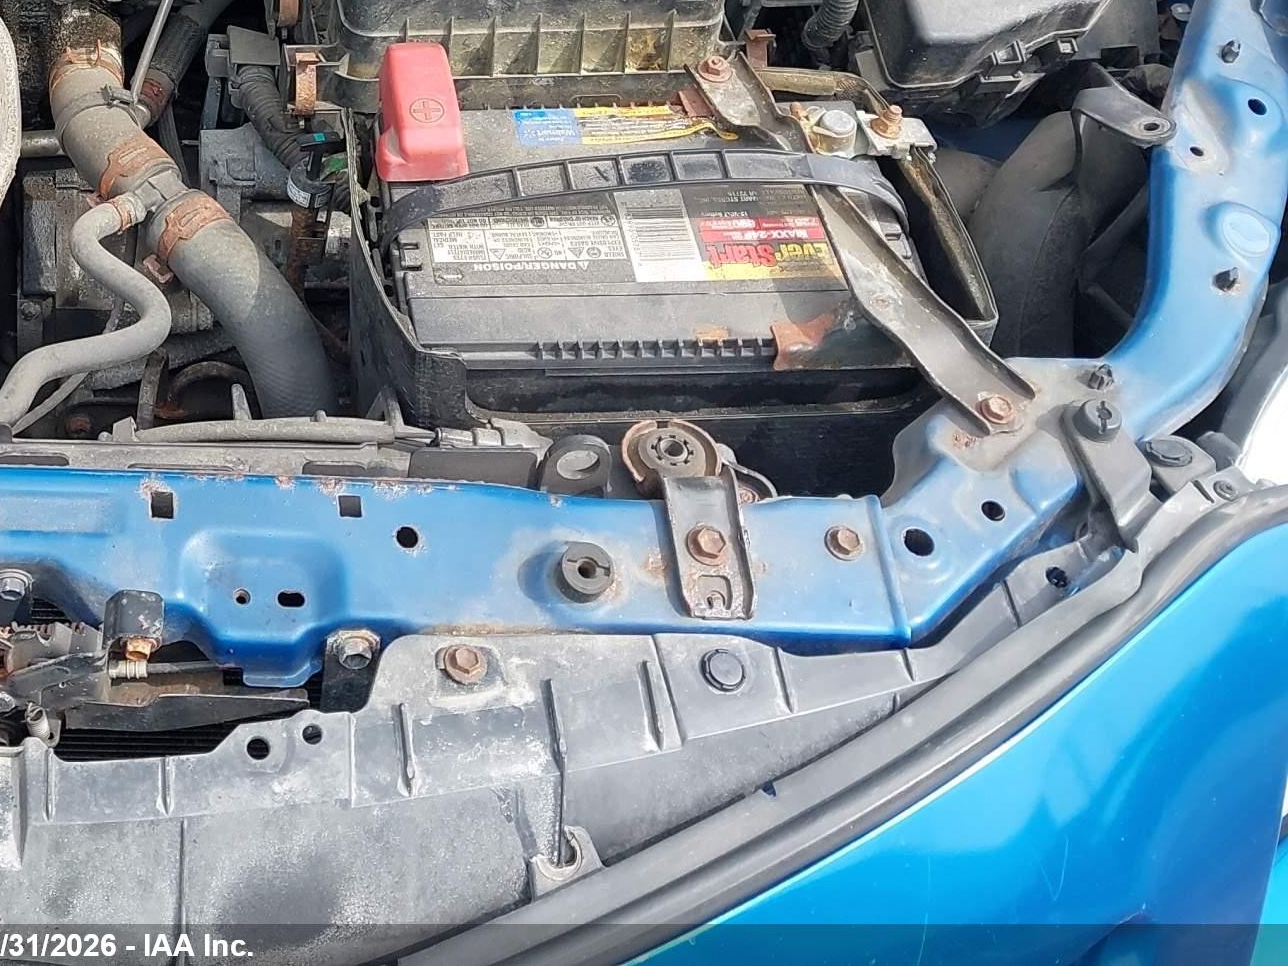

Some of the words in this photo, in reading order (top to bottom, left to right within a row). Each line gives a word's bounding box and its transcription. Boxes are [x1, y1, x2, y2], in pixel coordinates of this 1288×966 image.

[536, 129, 576, 137] Walmart
[705, 242, 829, 268] EverStart
[473, 261, 577, 271] DANGER/POISON
